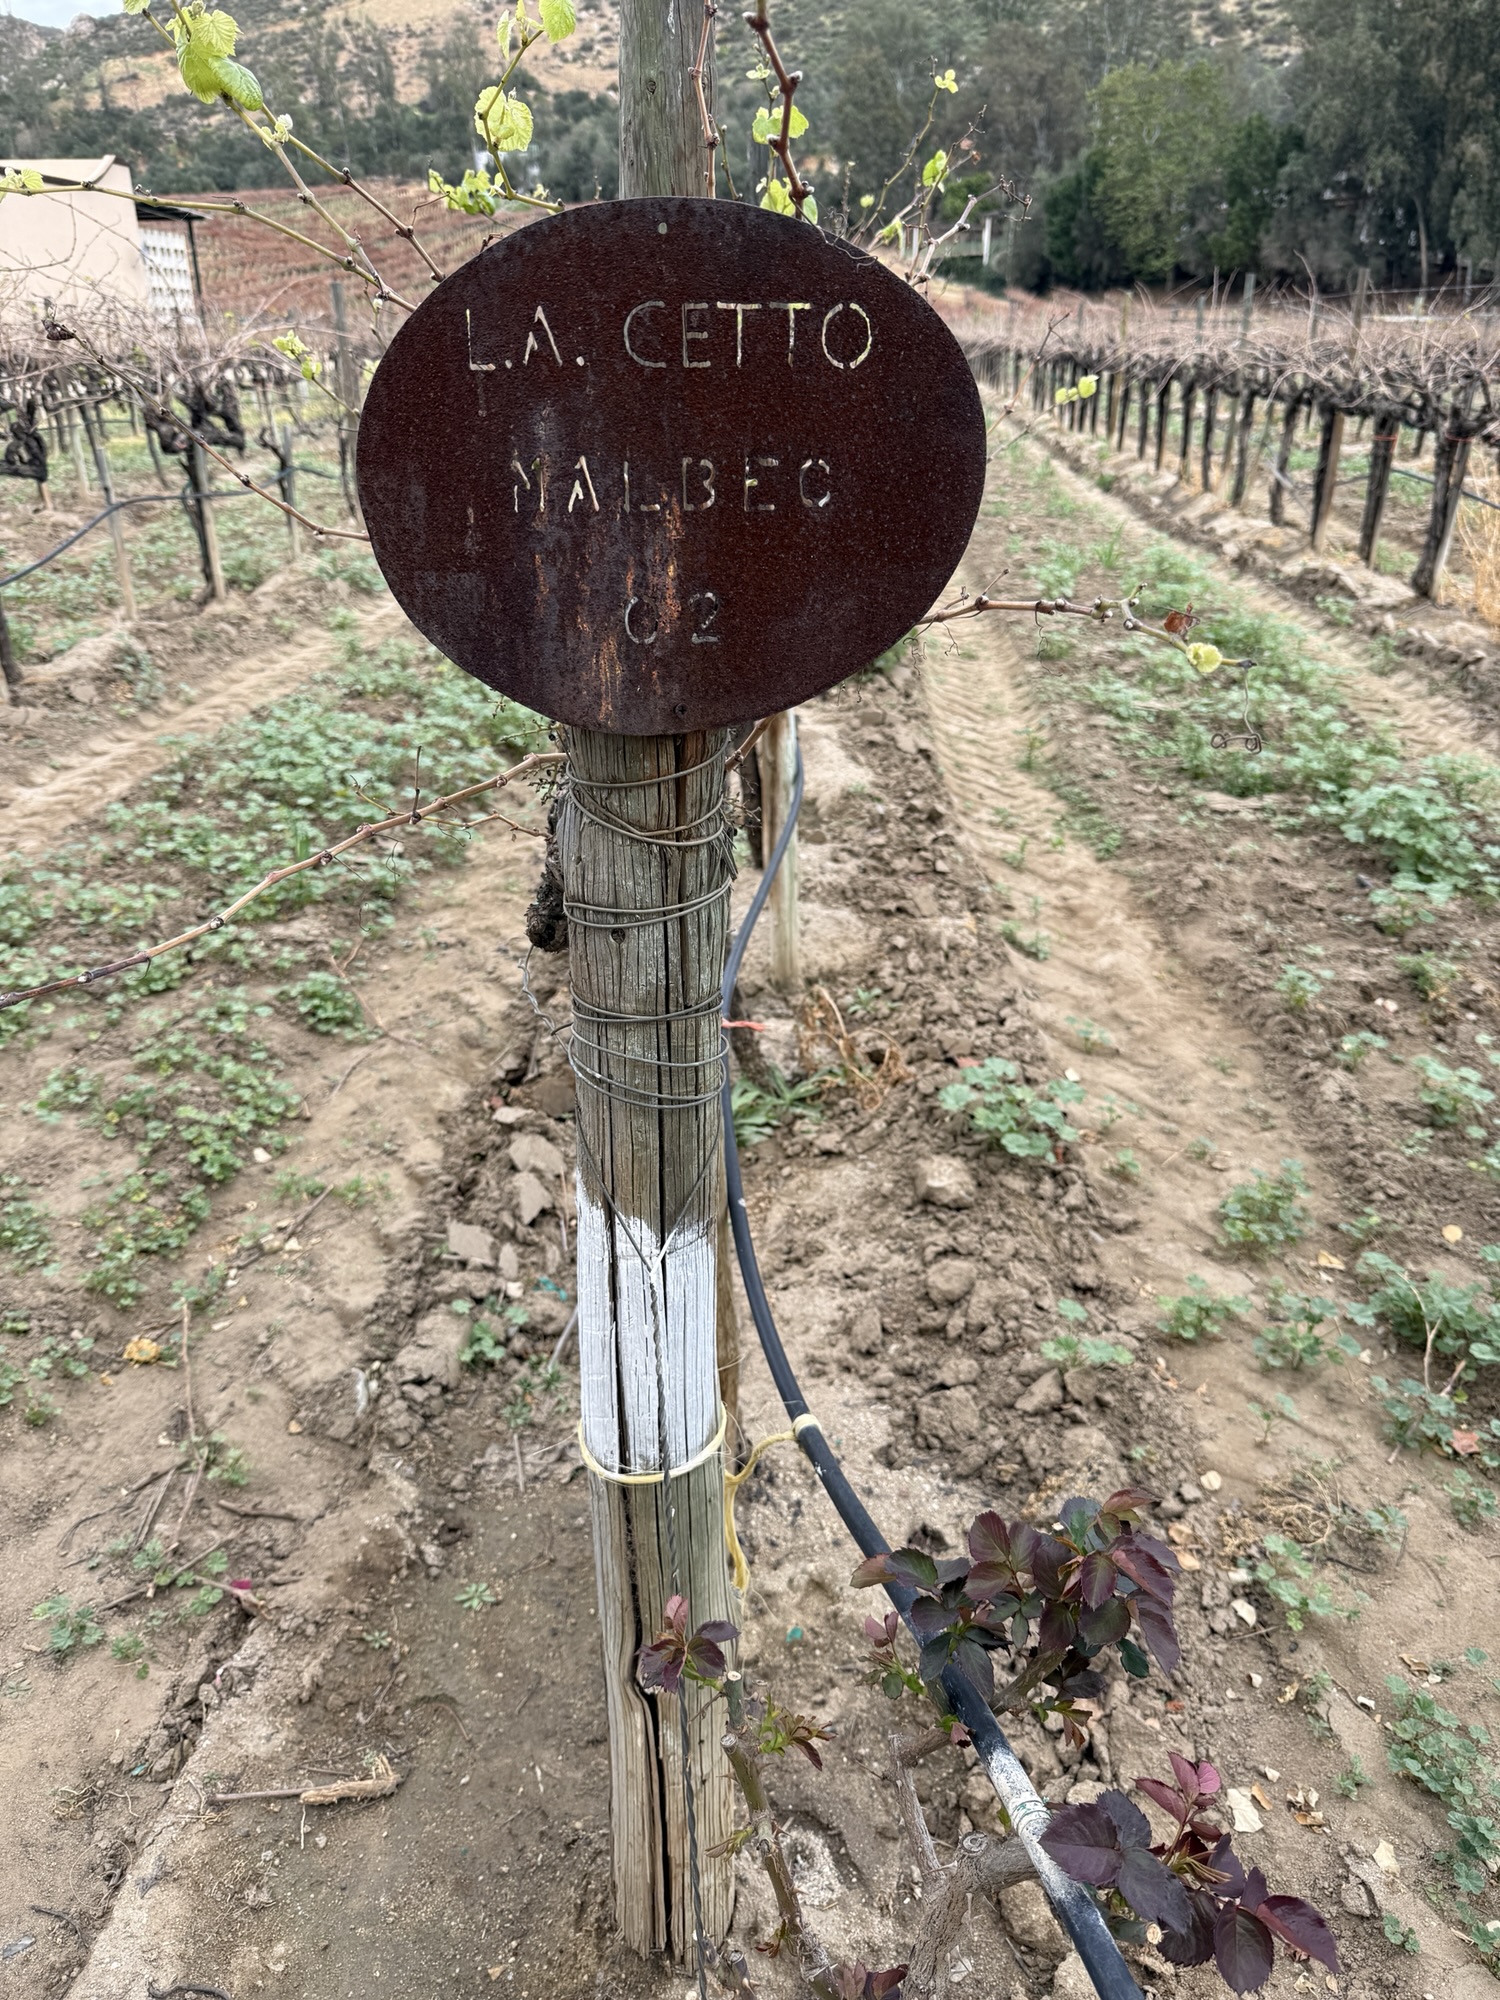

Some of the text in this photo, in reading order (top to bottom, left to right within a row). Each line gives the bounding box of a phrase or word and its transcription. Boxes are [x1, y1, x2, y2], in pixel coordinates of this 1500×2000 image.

[465, 300, 872, 371] L.A. CETTO
[511, 456, 831, 513] MALBEC
